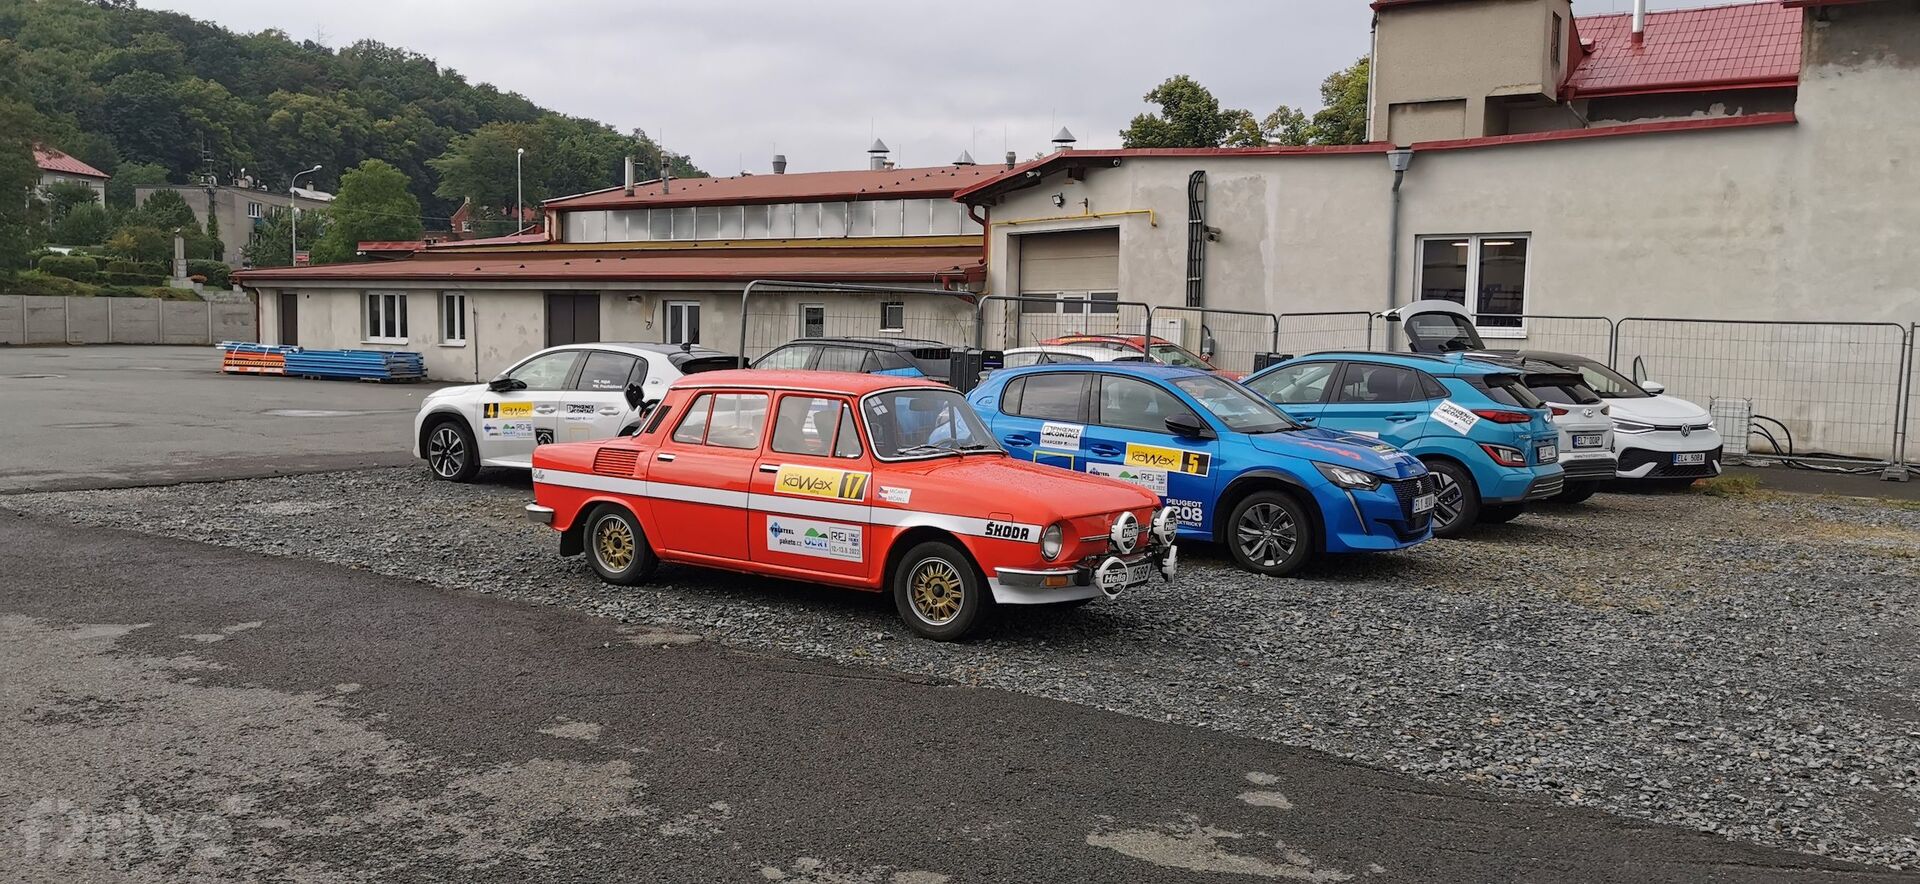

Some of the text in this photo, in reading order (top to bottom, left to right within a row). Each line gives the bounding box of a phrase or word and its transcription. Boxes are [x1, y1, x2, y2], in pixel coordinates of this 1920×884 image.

[488, 401, 495, 418] 4
[1050, 431, 1078, 439] CONTACT
[1131, 451, 1200, 474] koWax 5
[782, 473, 866, 499] koWax 17
[1166, 498, 1202, 508] PEUGEOT
[985, 522, 1029, 540] ŠKODA
[1104, 572, 1127, 583] Hella
